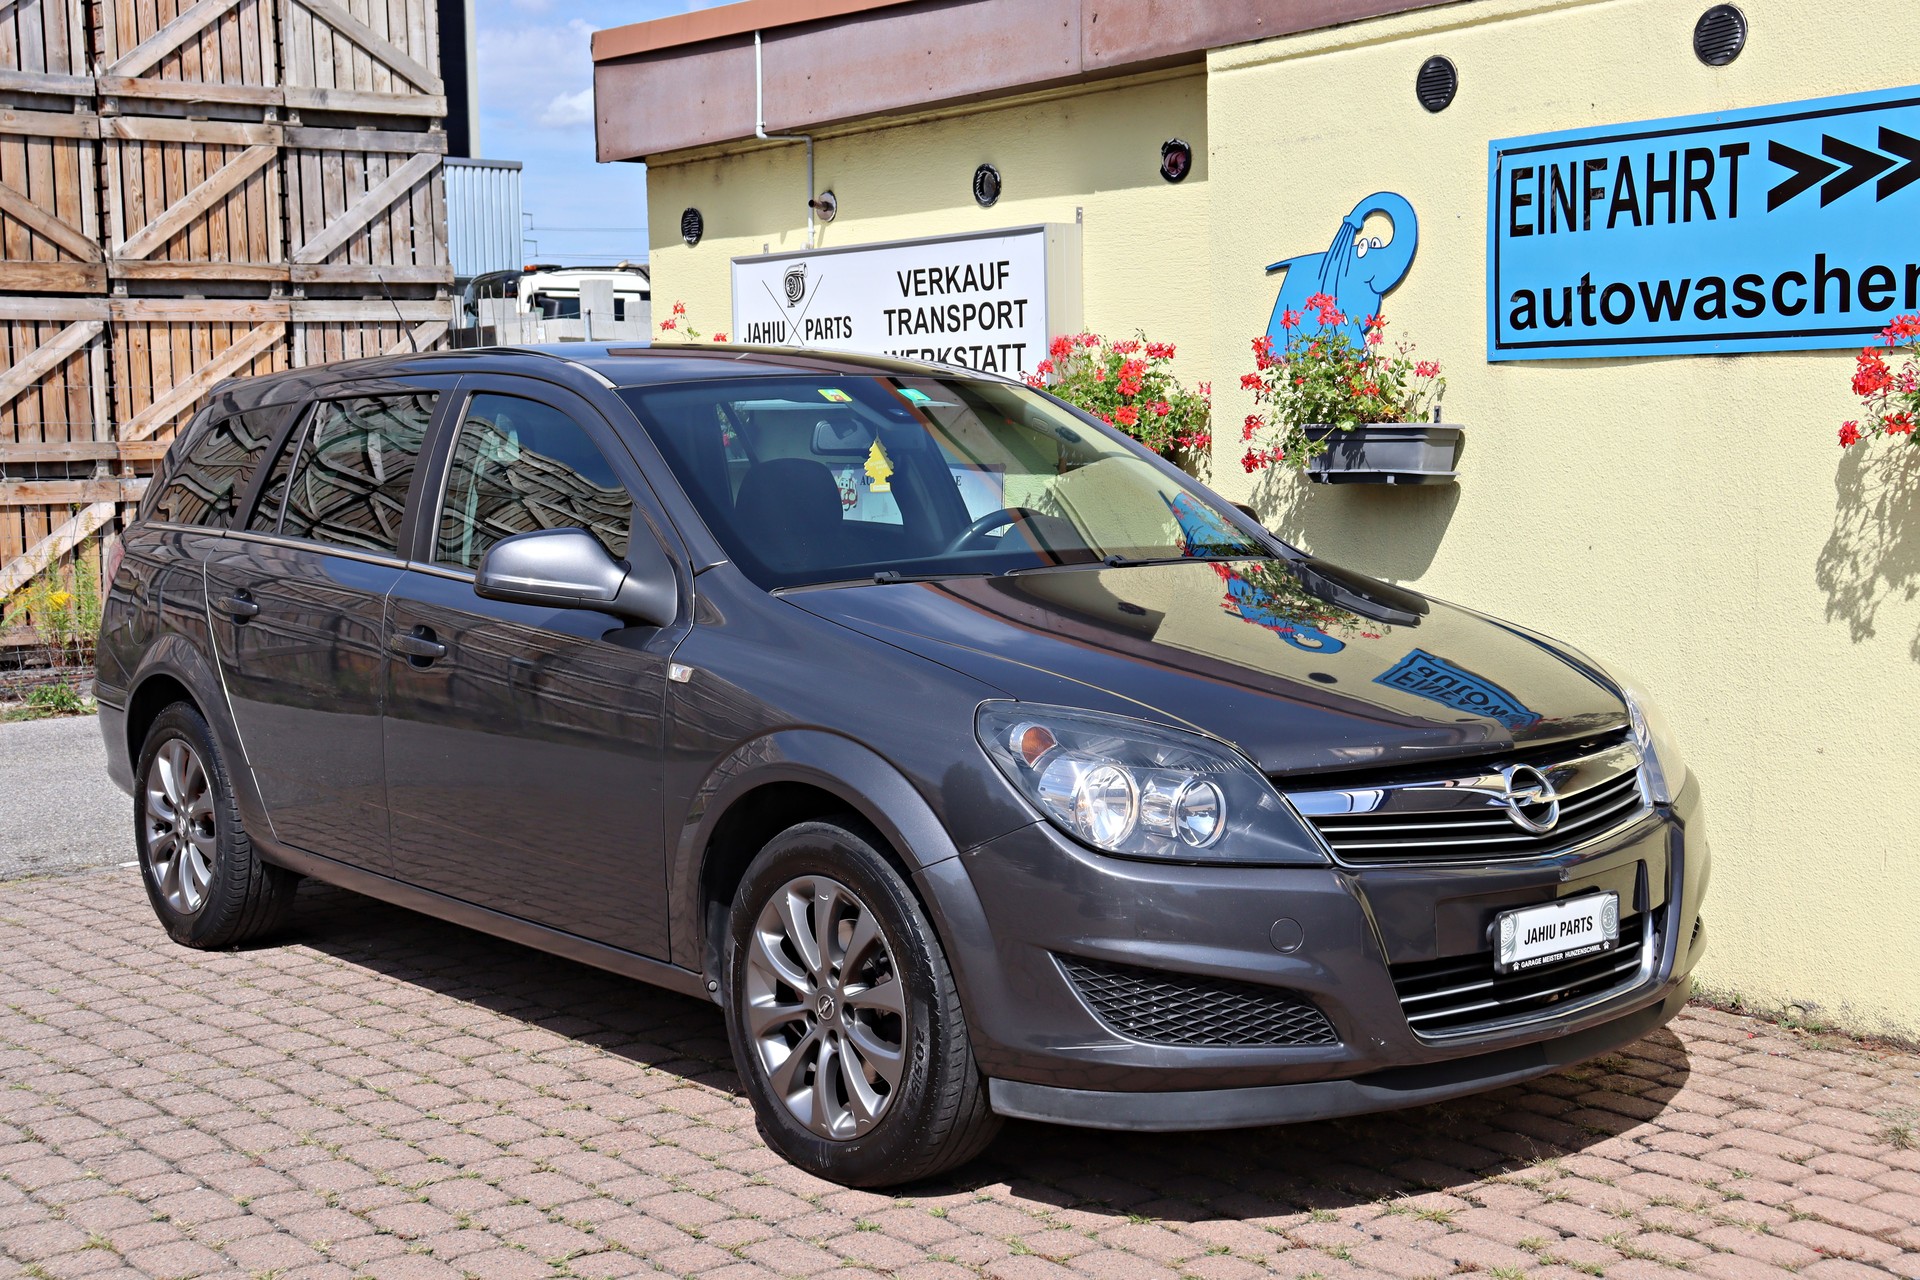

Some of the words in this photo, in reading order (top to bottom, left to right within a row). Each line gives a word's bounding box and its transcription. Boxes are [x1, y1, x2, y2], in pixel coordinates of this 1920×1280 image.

[1510, 141, 1750, 238] EINFAHRT
[897, 260, 1010, 298] VERKAUF
[744, 320, 786, 344] JAHIU
[805, 316, 852, 341] PARTS
[883, 299, 1028, 336] TRANSPORT
[884, 343, 1027, 372] KSTATT
[1524, 923, 1556, 945] JAHIU
[1560, 915, 1593, 938] PARTS
[1520, 957, 1542, 969] GARAGE
[1542, 952, 1564, 964] MEISTER
